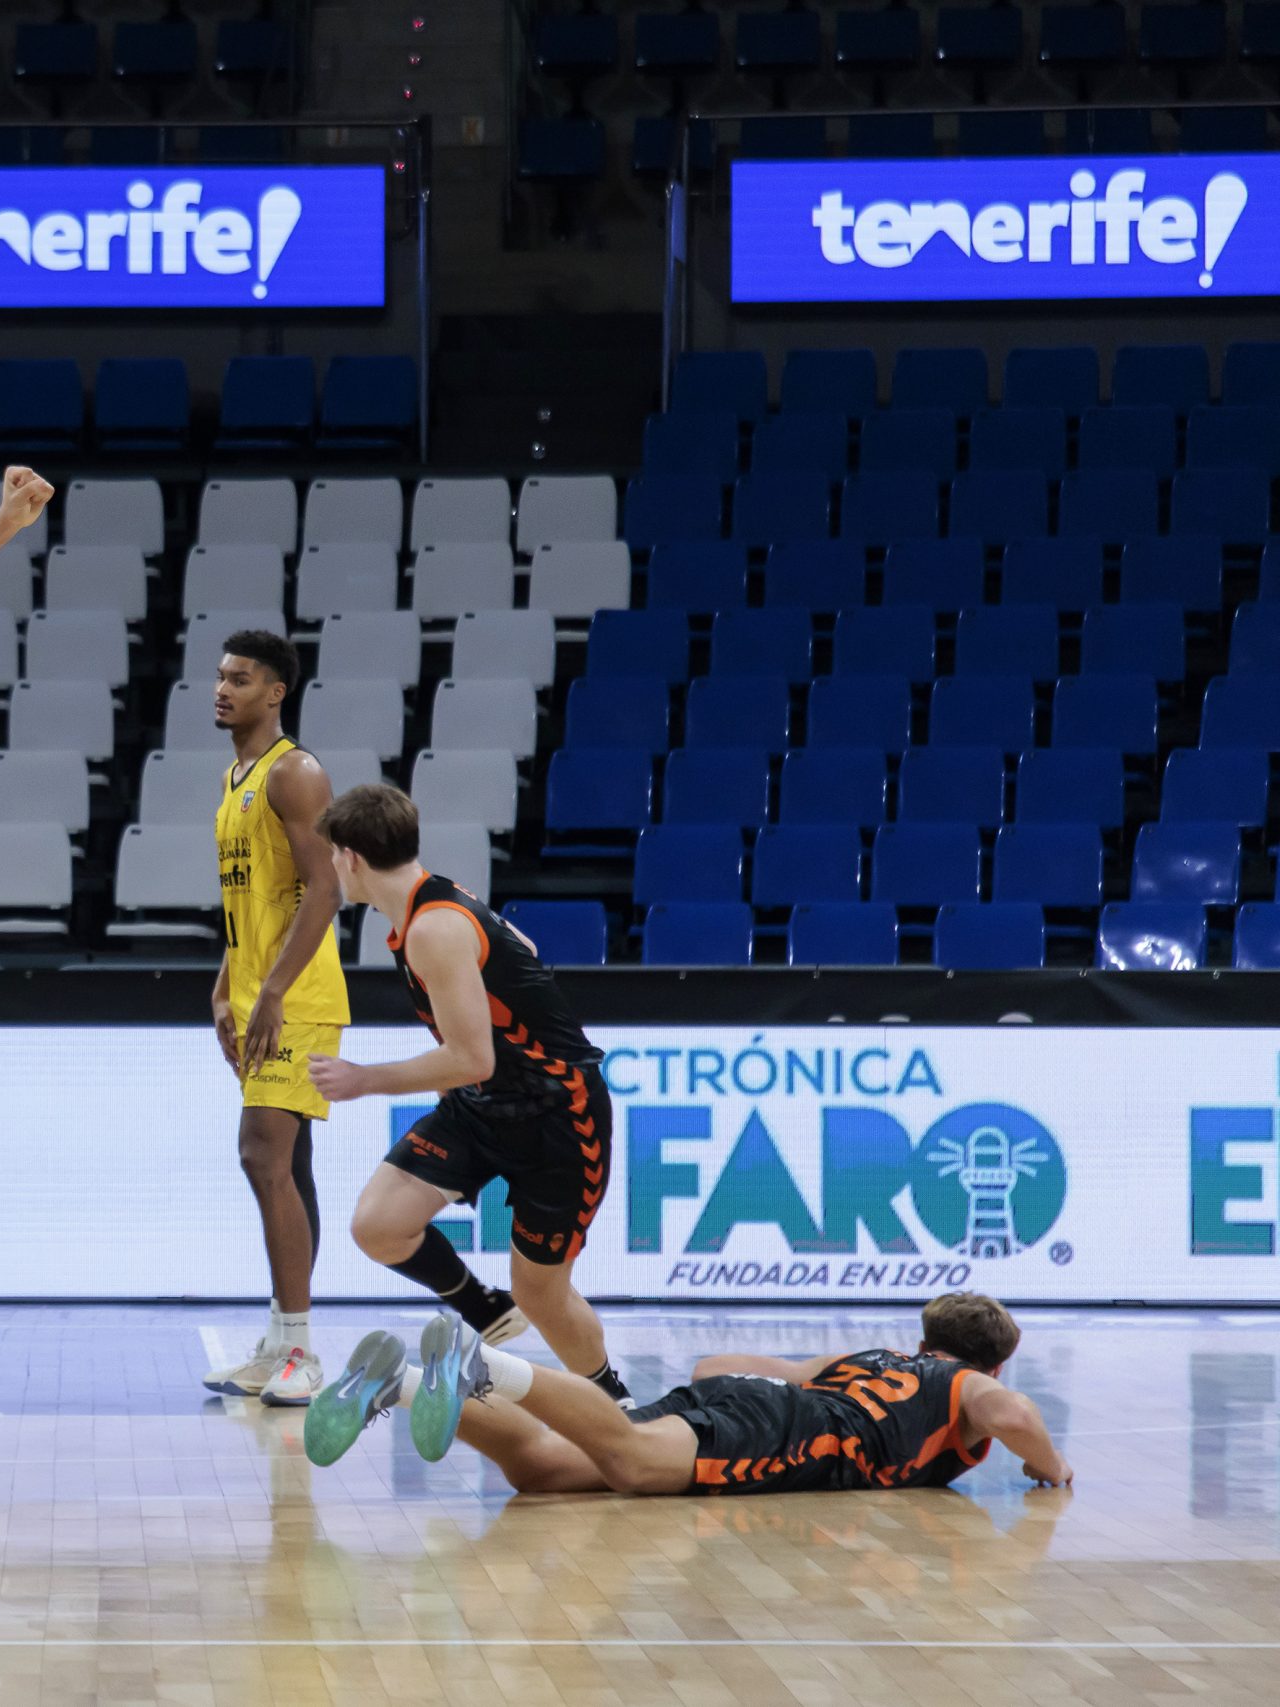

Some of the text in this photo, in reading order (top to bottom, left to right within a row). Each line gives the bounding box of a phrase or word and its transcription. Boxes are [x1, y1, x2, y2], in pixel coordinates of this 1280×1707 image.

[812, 168, 1248, 289] tenerife!
[626, 1102, 1069, 1257] FARO
[1190, 1106, 1280, 1257] E
[666, 1261, 973, 1287] FUNDADA EN 1970
